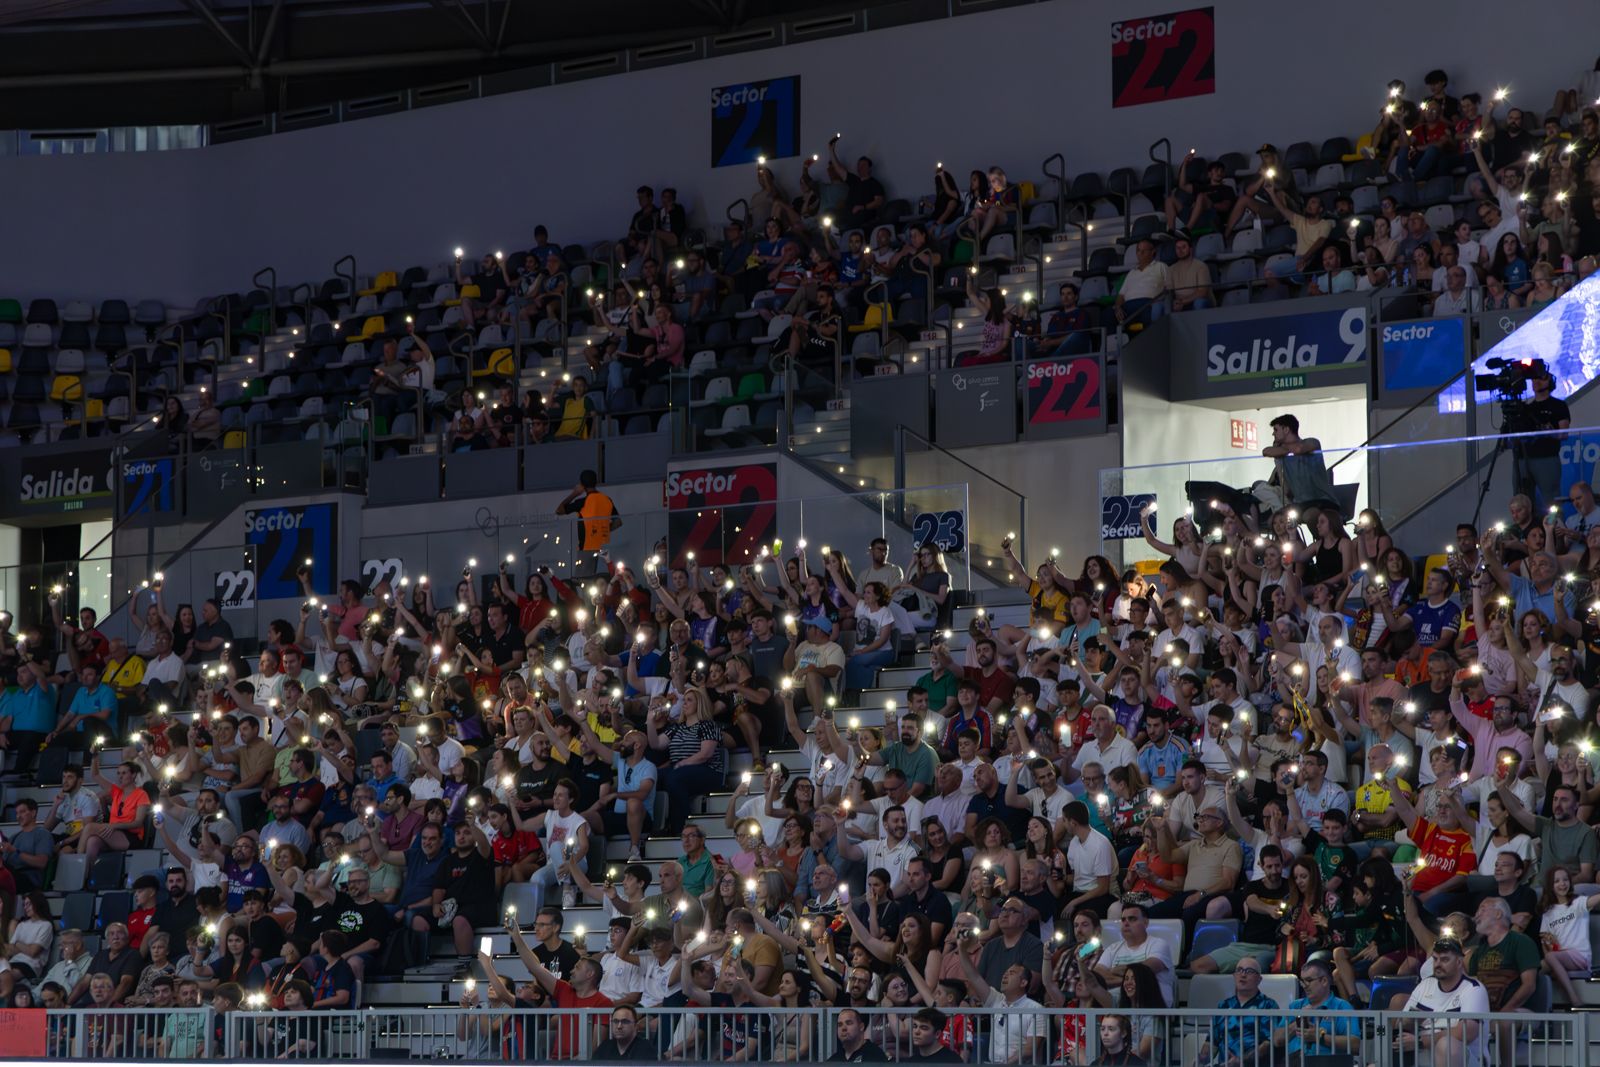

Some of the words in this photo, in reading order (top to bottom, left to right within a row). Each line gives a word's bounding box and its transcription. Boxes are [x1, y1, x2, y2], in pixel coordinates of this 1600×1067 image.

[1112, 19, 1176, 45] Sector
[1112, 9, 1215, 107] 22
[712, 86, 768, 109] Sector
[713, 79, 795, 167] 21
[1207, 335, 1319, 377] Salida
[1338, 307, 1367, 364] 9
[1383, 325, 1435, 343] Sector
[1028, 363, 1073, 380] Sector
[1274, 376, 1304, 388] SALIDA
[1029, 358, 1101, 425] 22
[20, 467, 95, 501] Salida
[123, 463, 158, 477] Sector
[666, 472, 737, 497] Sector
[125, 458, 174, 516] 21
[245, 510, 304, 533] Sector
[668, 465, 777, 570] 22
[913, 510, 966, 554] 23
[1102, 524, 1144, 538] Sector
[246, 503, 332, 600] 21
[216, 570, 255, 609] 22
[219, 598, 244, 608] ector
